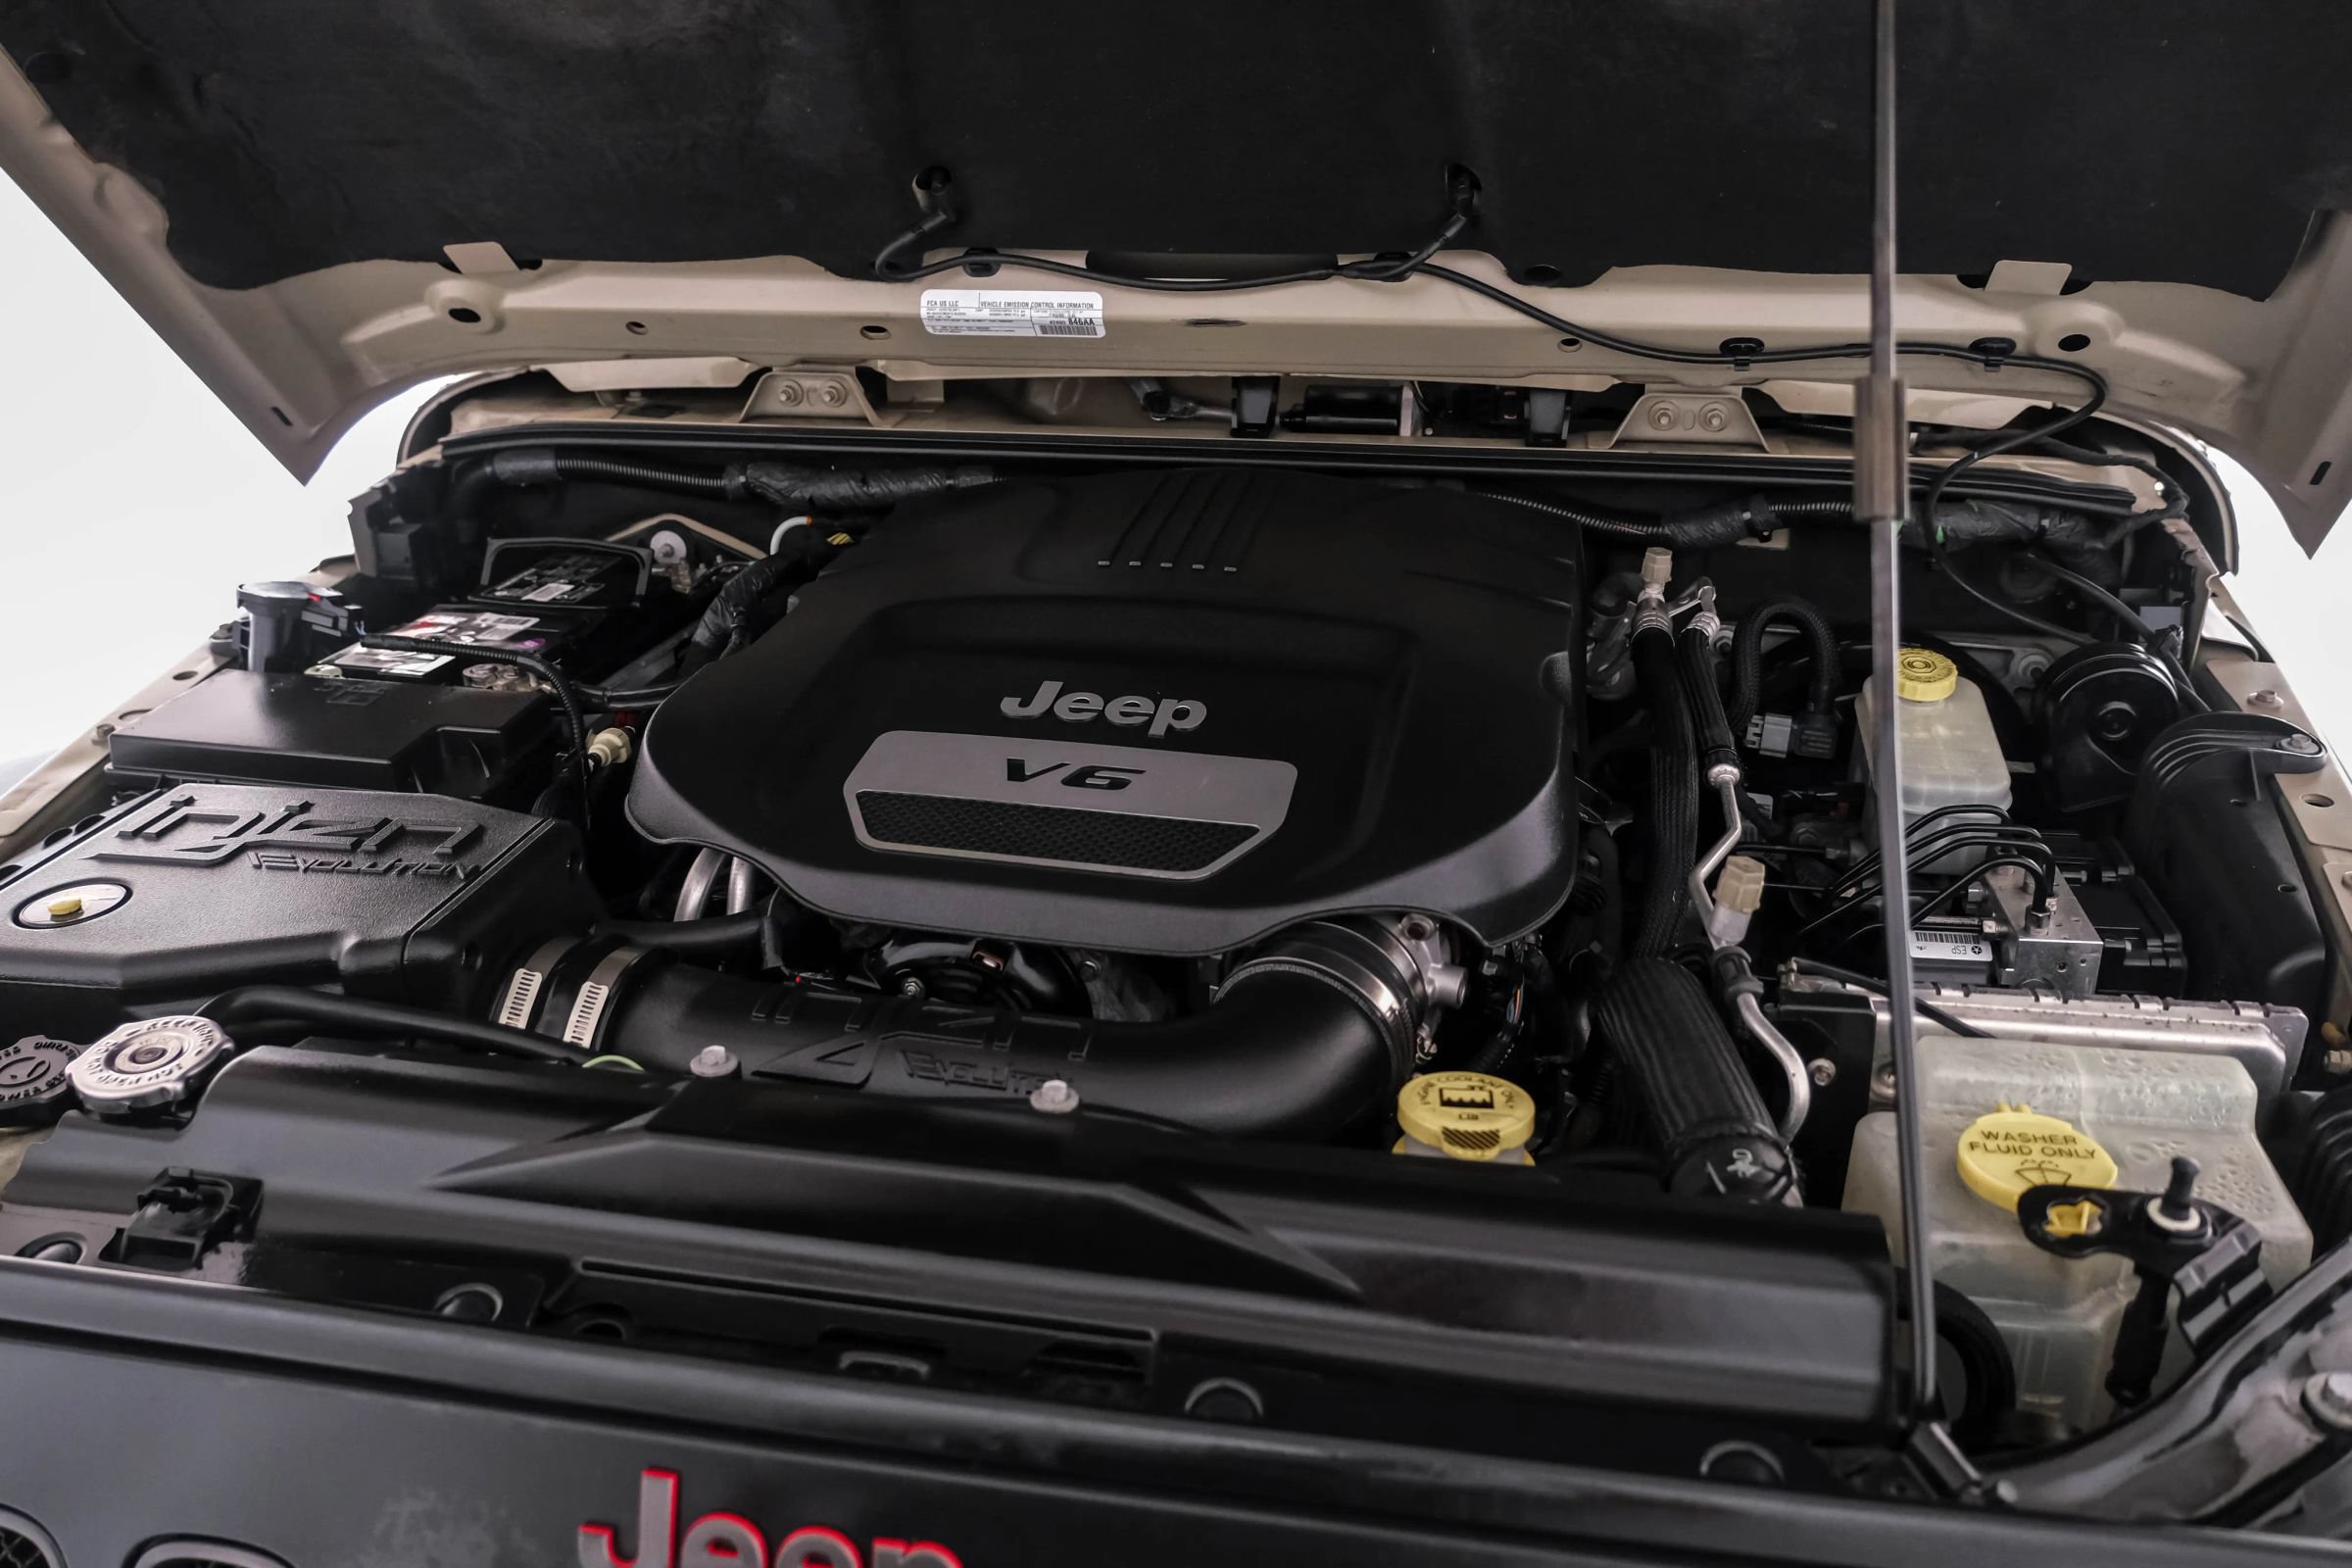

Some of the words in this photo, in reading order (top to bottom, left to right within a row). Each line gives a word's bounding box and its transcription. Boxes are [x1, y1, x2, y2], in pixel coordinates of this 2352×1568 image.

[1000, 680, 1207, 739] Jeep
[1005, 758, 1148, 791] V6
[1950, 945, 1968, 956] ESP
[1981, 1130, 2079, 1146] WASHER
[1969, 1141, 2034, 1156] FLUID
[2040, 1145, 2097, 1160] ONLY
